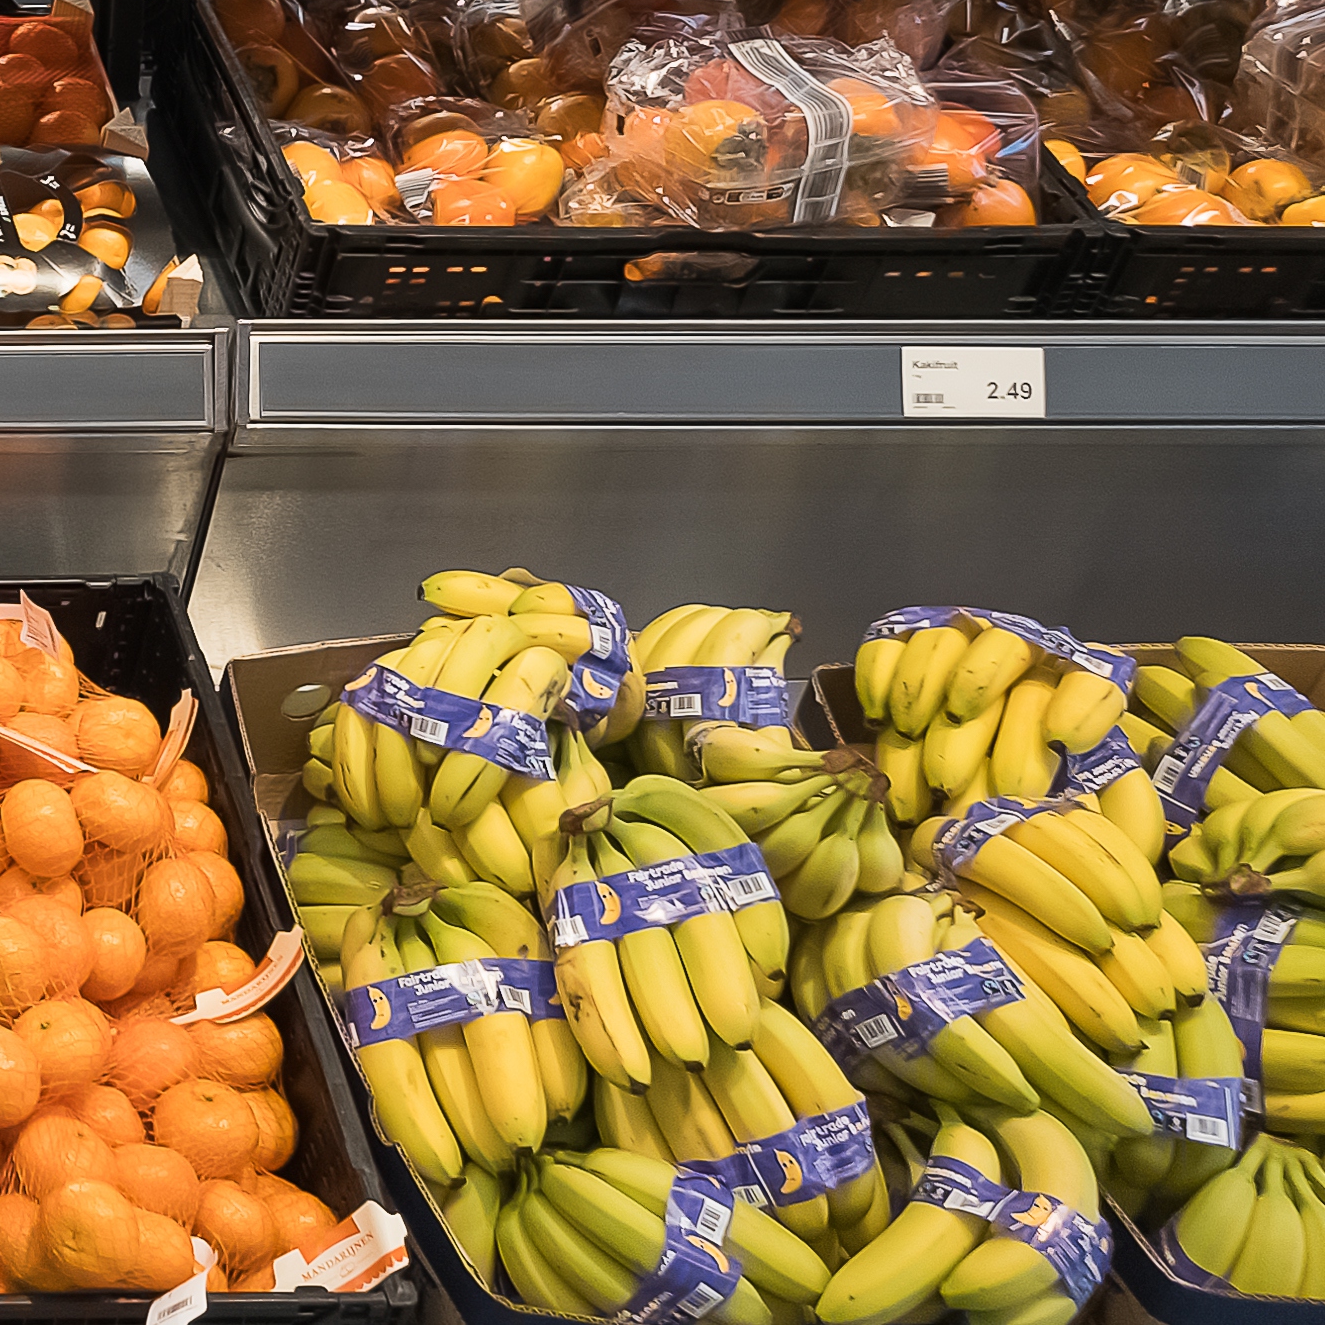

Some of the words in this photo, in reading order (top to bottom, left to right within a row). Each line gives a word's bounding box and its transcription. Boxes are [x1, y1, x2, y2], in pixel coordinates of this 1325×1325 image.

[986, 381, 1033, 400] 2.49
[628, 859, 686, 885] Fairtrade
[645, 873, 683, 892] Junior
[301, 1231, 374, 1282] MANDARIJNEN
